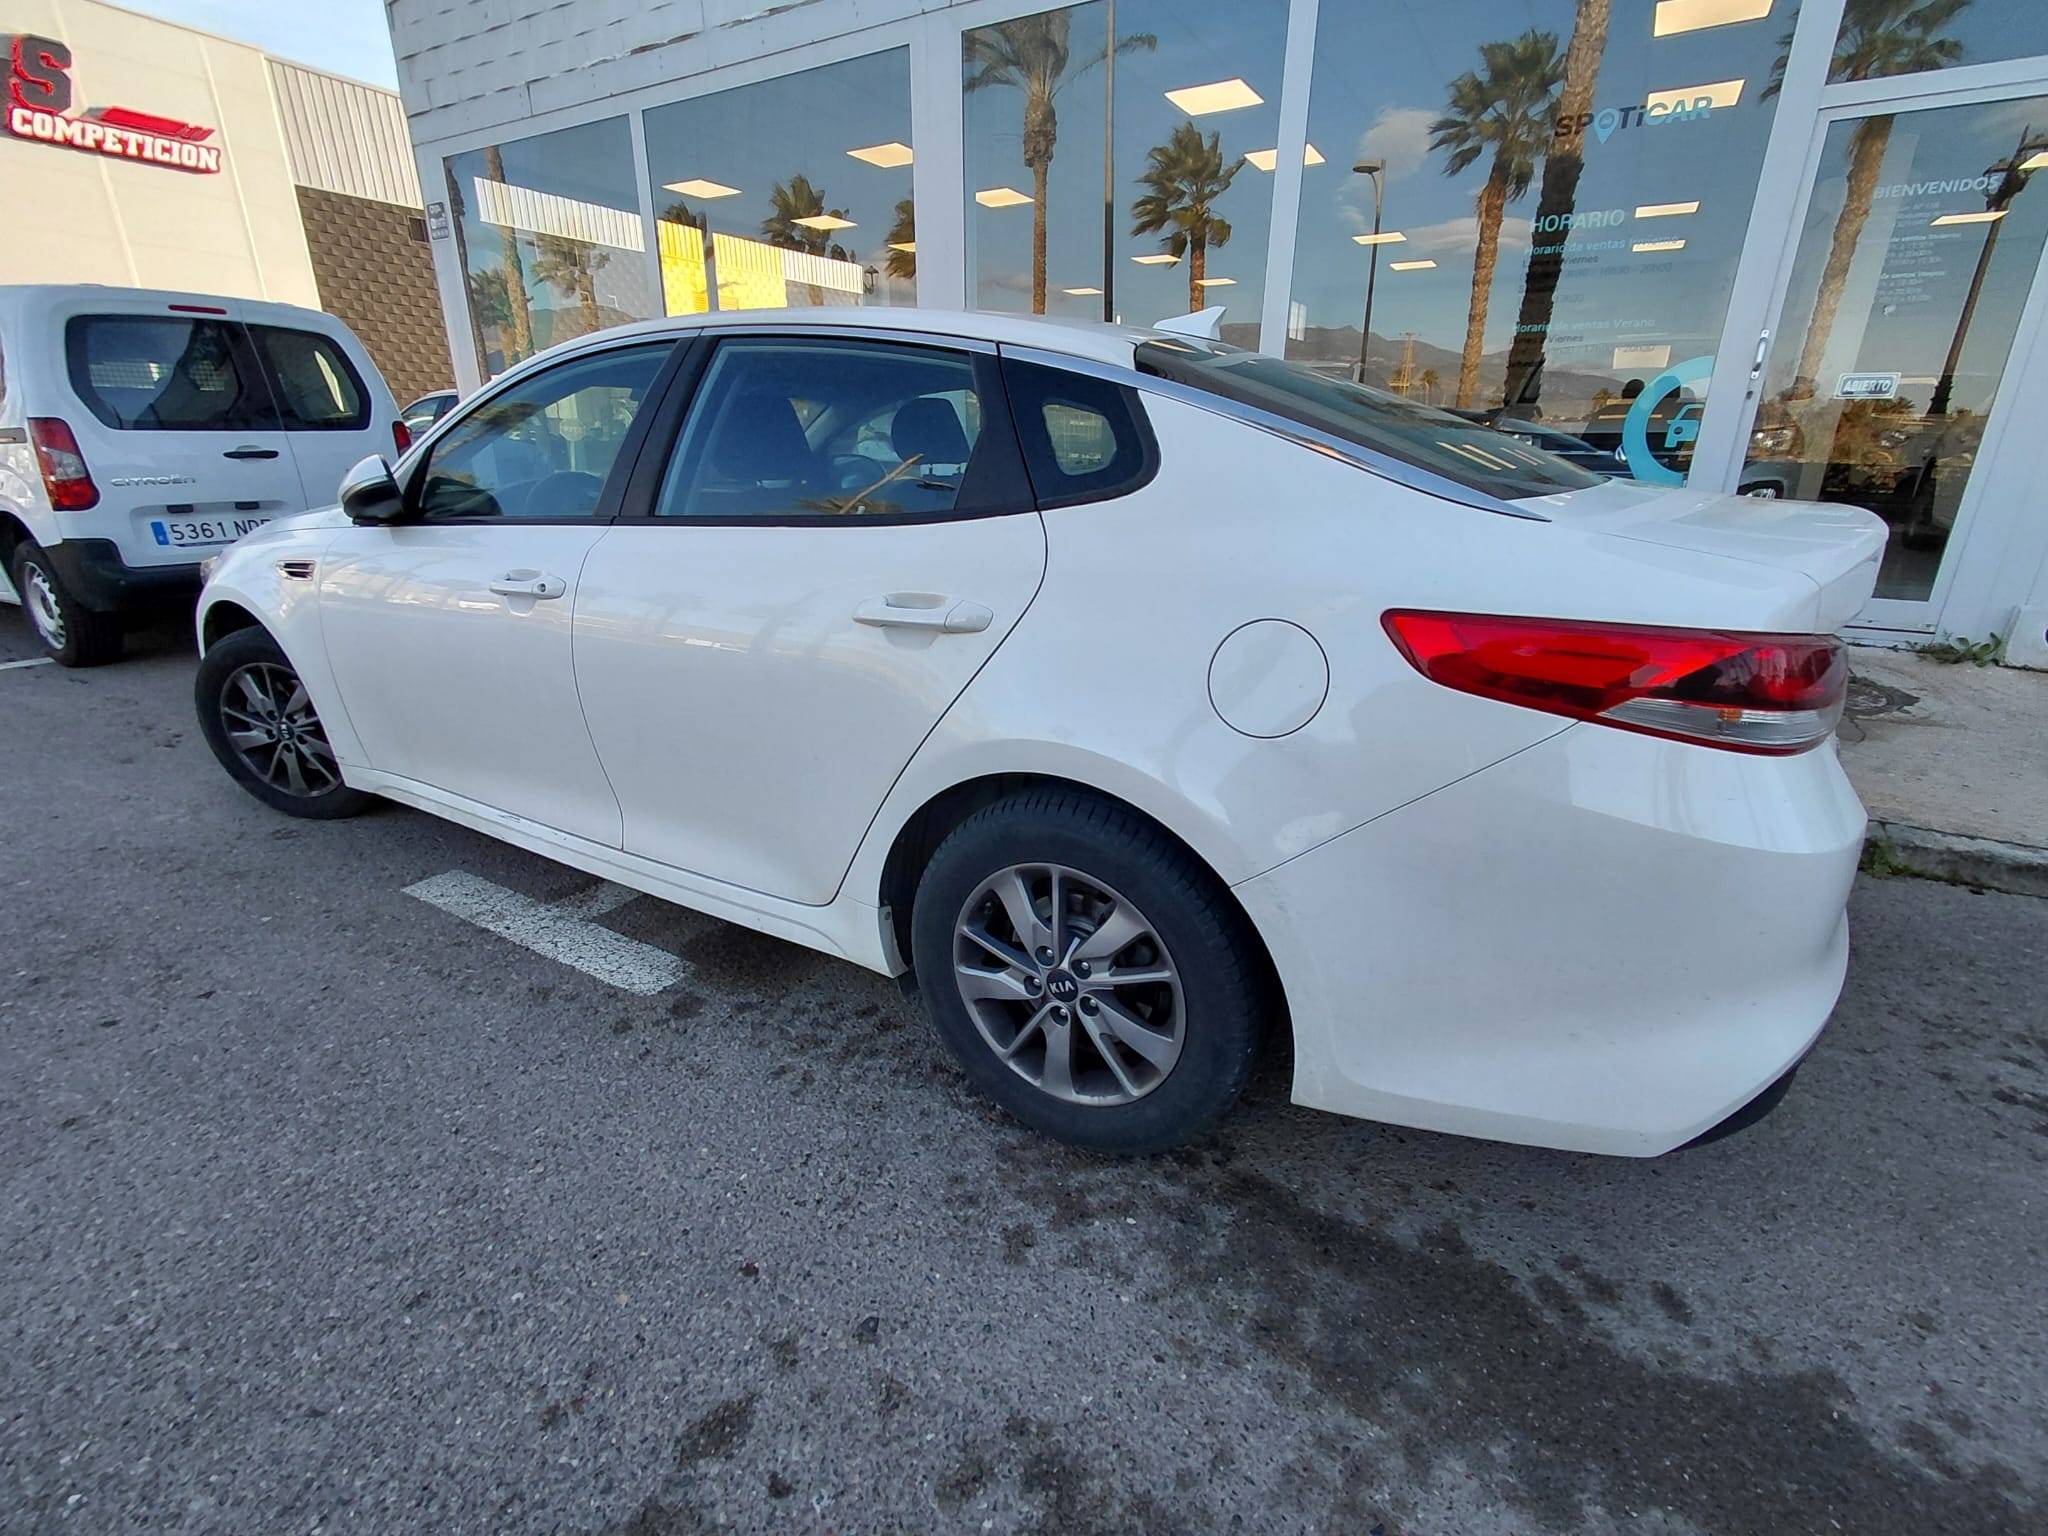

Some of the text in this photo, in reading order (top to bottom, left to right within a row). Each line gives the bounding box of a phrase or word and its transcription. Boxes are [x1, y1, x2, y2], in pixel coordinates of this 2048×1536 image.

[11, 107, 219, 171] COMPETICION
[1873, 175, 2000, 199] BIENVENIDOS
[1531, 209, 1625, 232] HORARIO
[1586, 239, 1626, 251] ventas
[1613, 318, 1656, 329] Verano
[1549, 334, 1584, 344] Viernes
[1843, 379, 1891, 392] ABIERTO
[170, 518, 271, 541] 5361 ND
[1048, 980, 1075, 994] KIA
